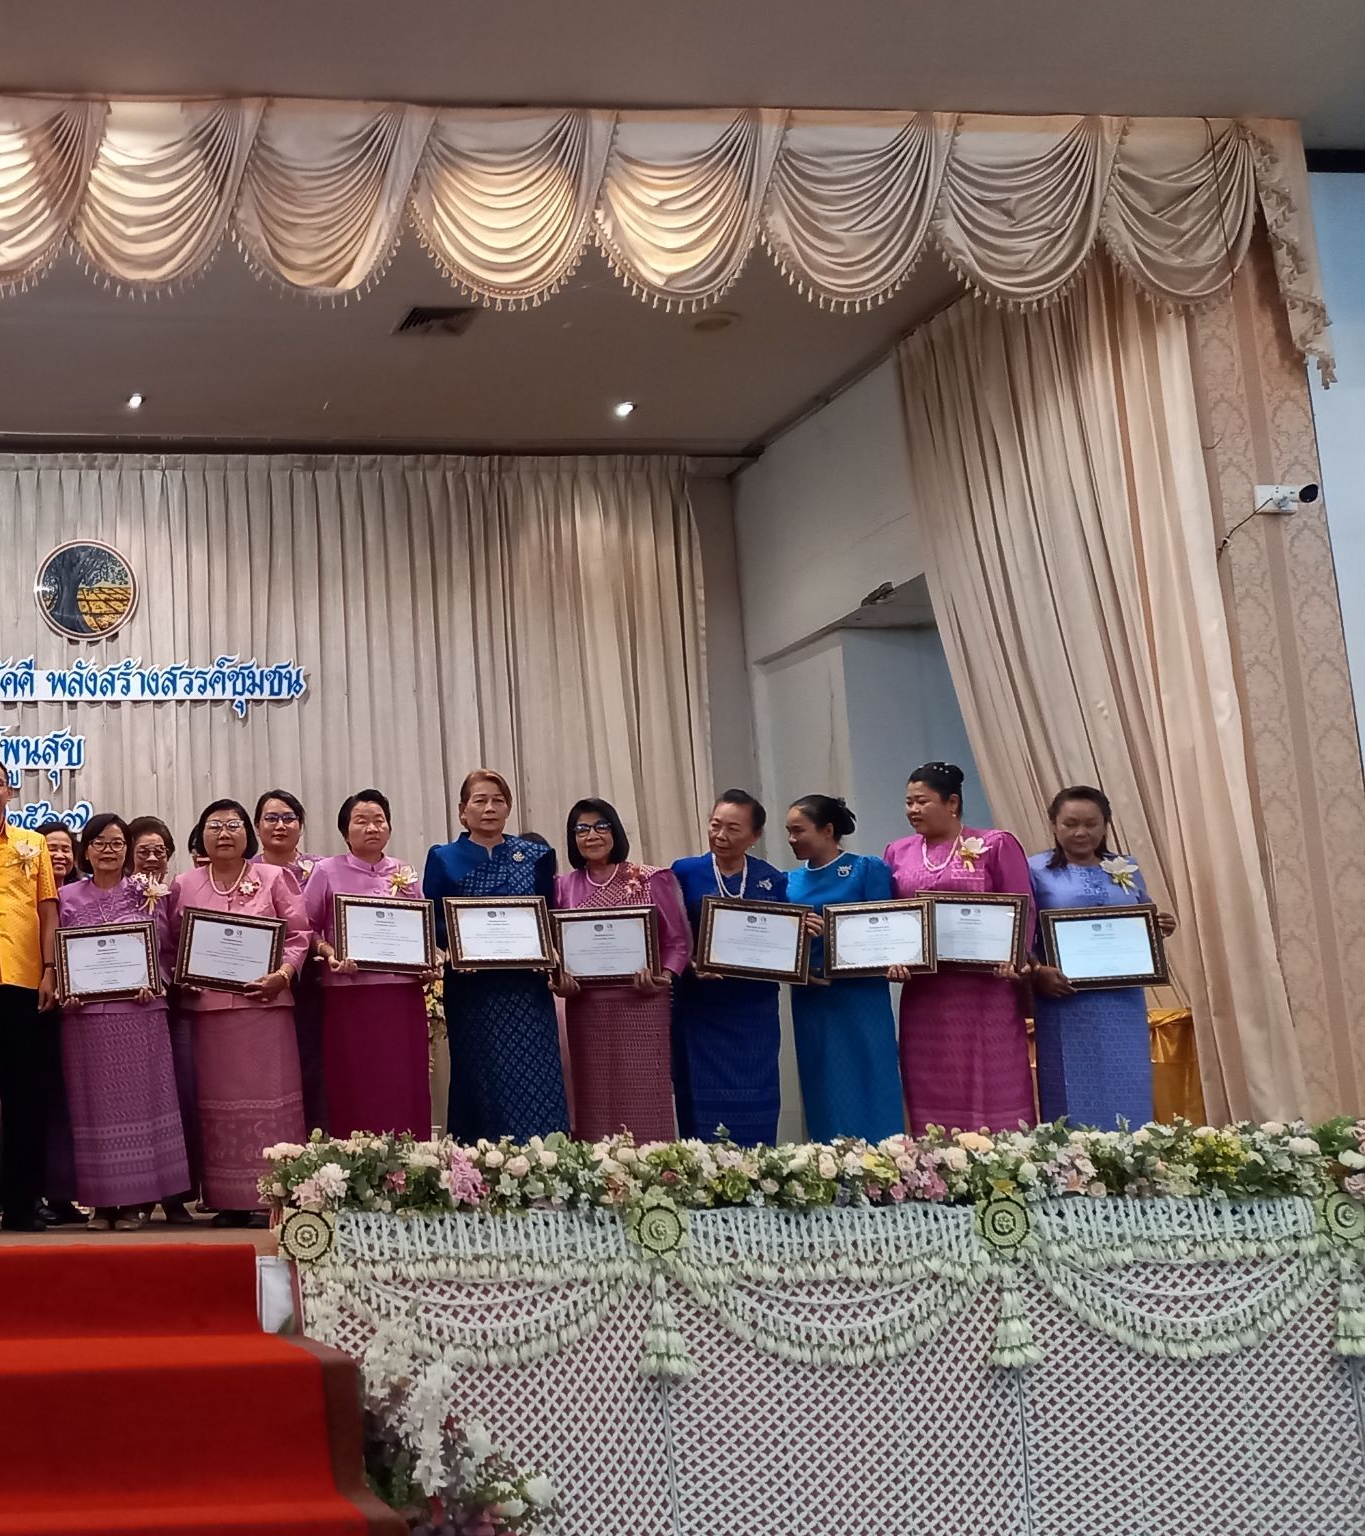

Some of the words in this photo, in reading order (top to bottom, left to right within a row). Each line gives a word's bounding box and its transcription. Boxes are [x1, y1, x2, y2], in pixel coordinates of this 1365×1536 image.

[46, 656, 304, 716] พลังสร้างสรรค์ชุมชน
